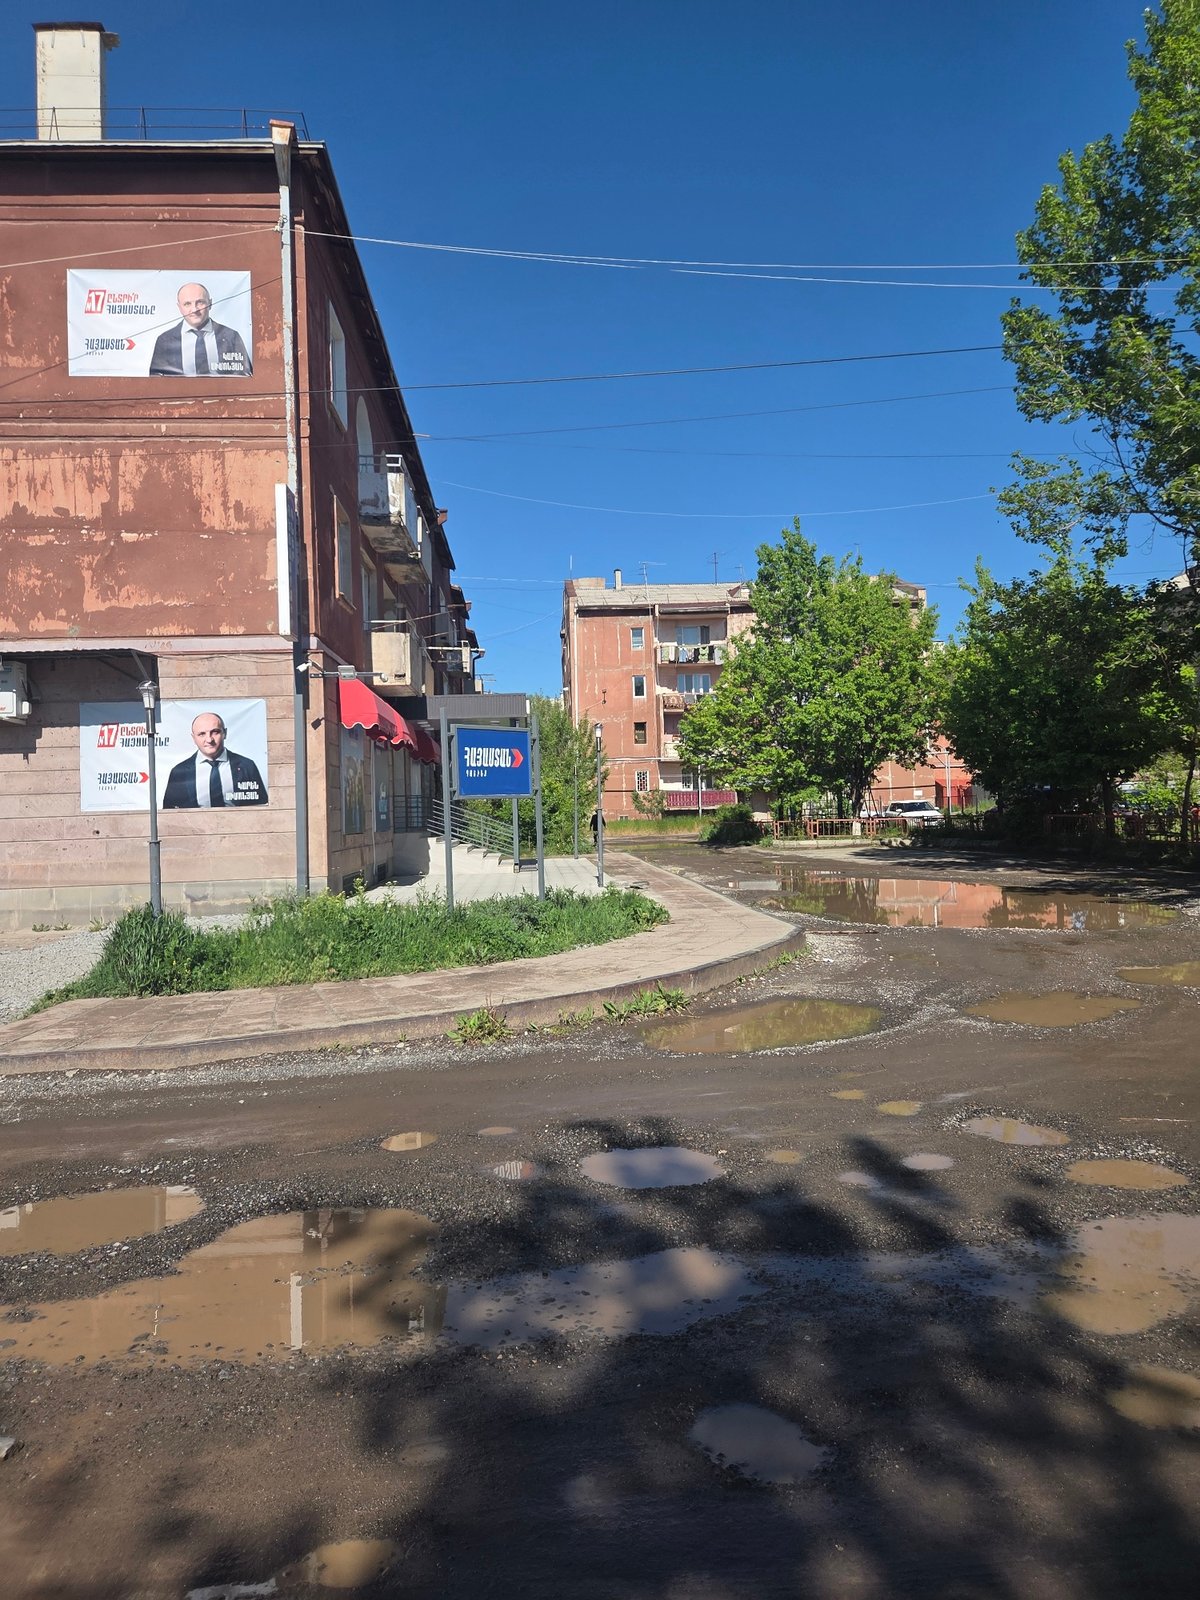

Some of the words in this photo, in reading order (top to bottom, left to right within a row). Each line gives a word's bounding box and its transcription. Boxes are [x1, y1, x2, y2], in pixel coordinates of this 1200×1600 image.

[106, 304, 156, 315] ՀԱՅԱՍՏԱՆԸ
[85, 338, 125, 351] ՀԱՅԱՍՏԱՆ
[464, 746, 512, 768] ՀԱՅԱՍՏԱՆ
[97, 772, 139, 785] ՀԱՅԱՍՏԱՆ
[237, 781, 259, 790] ԿԱՐԵՆ
